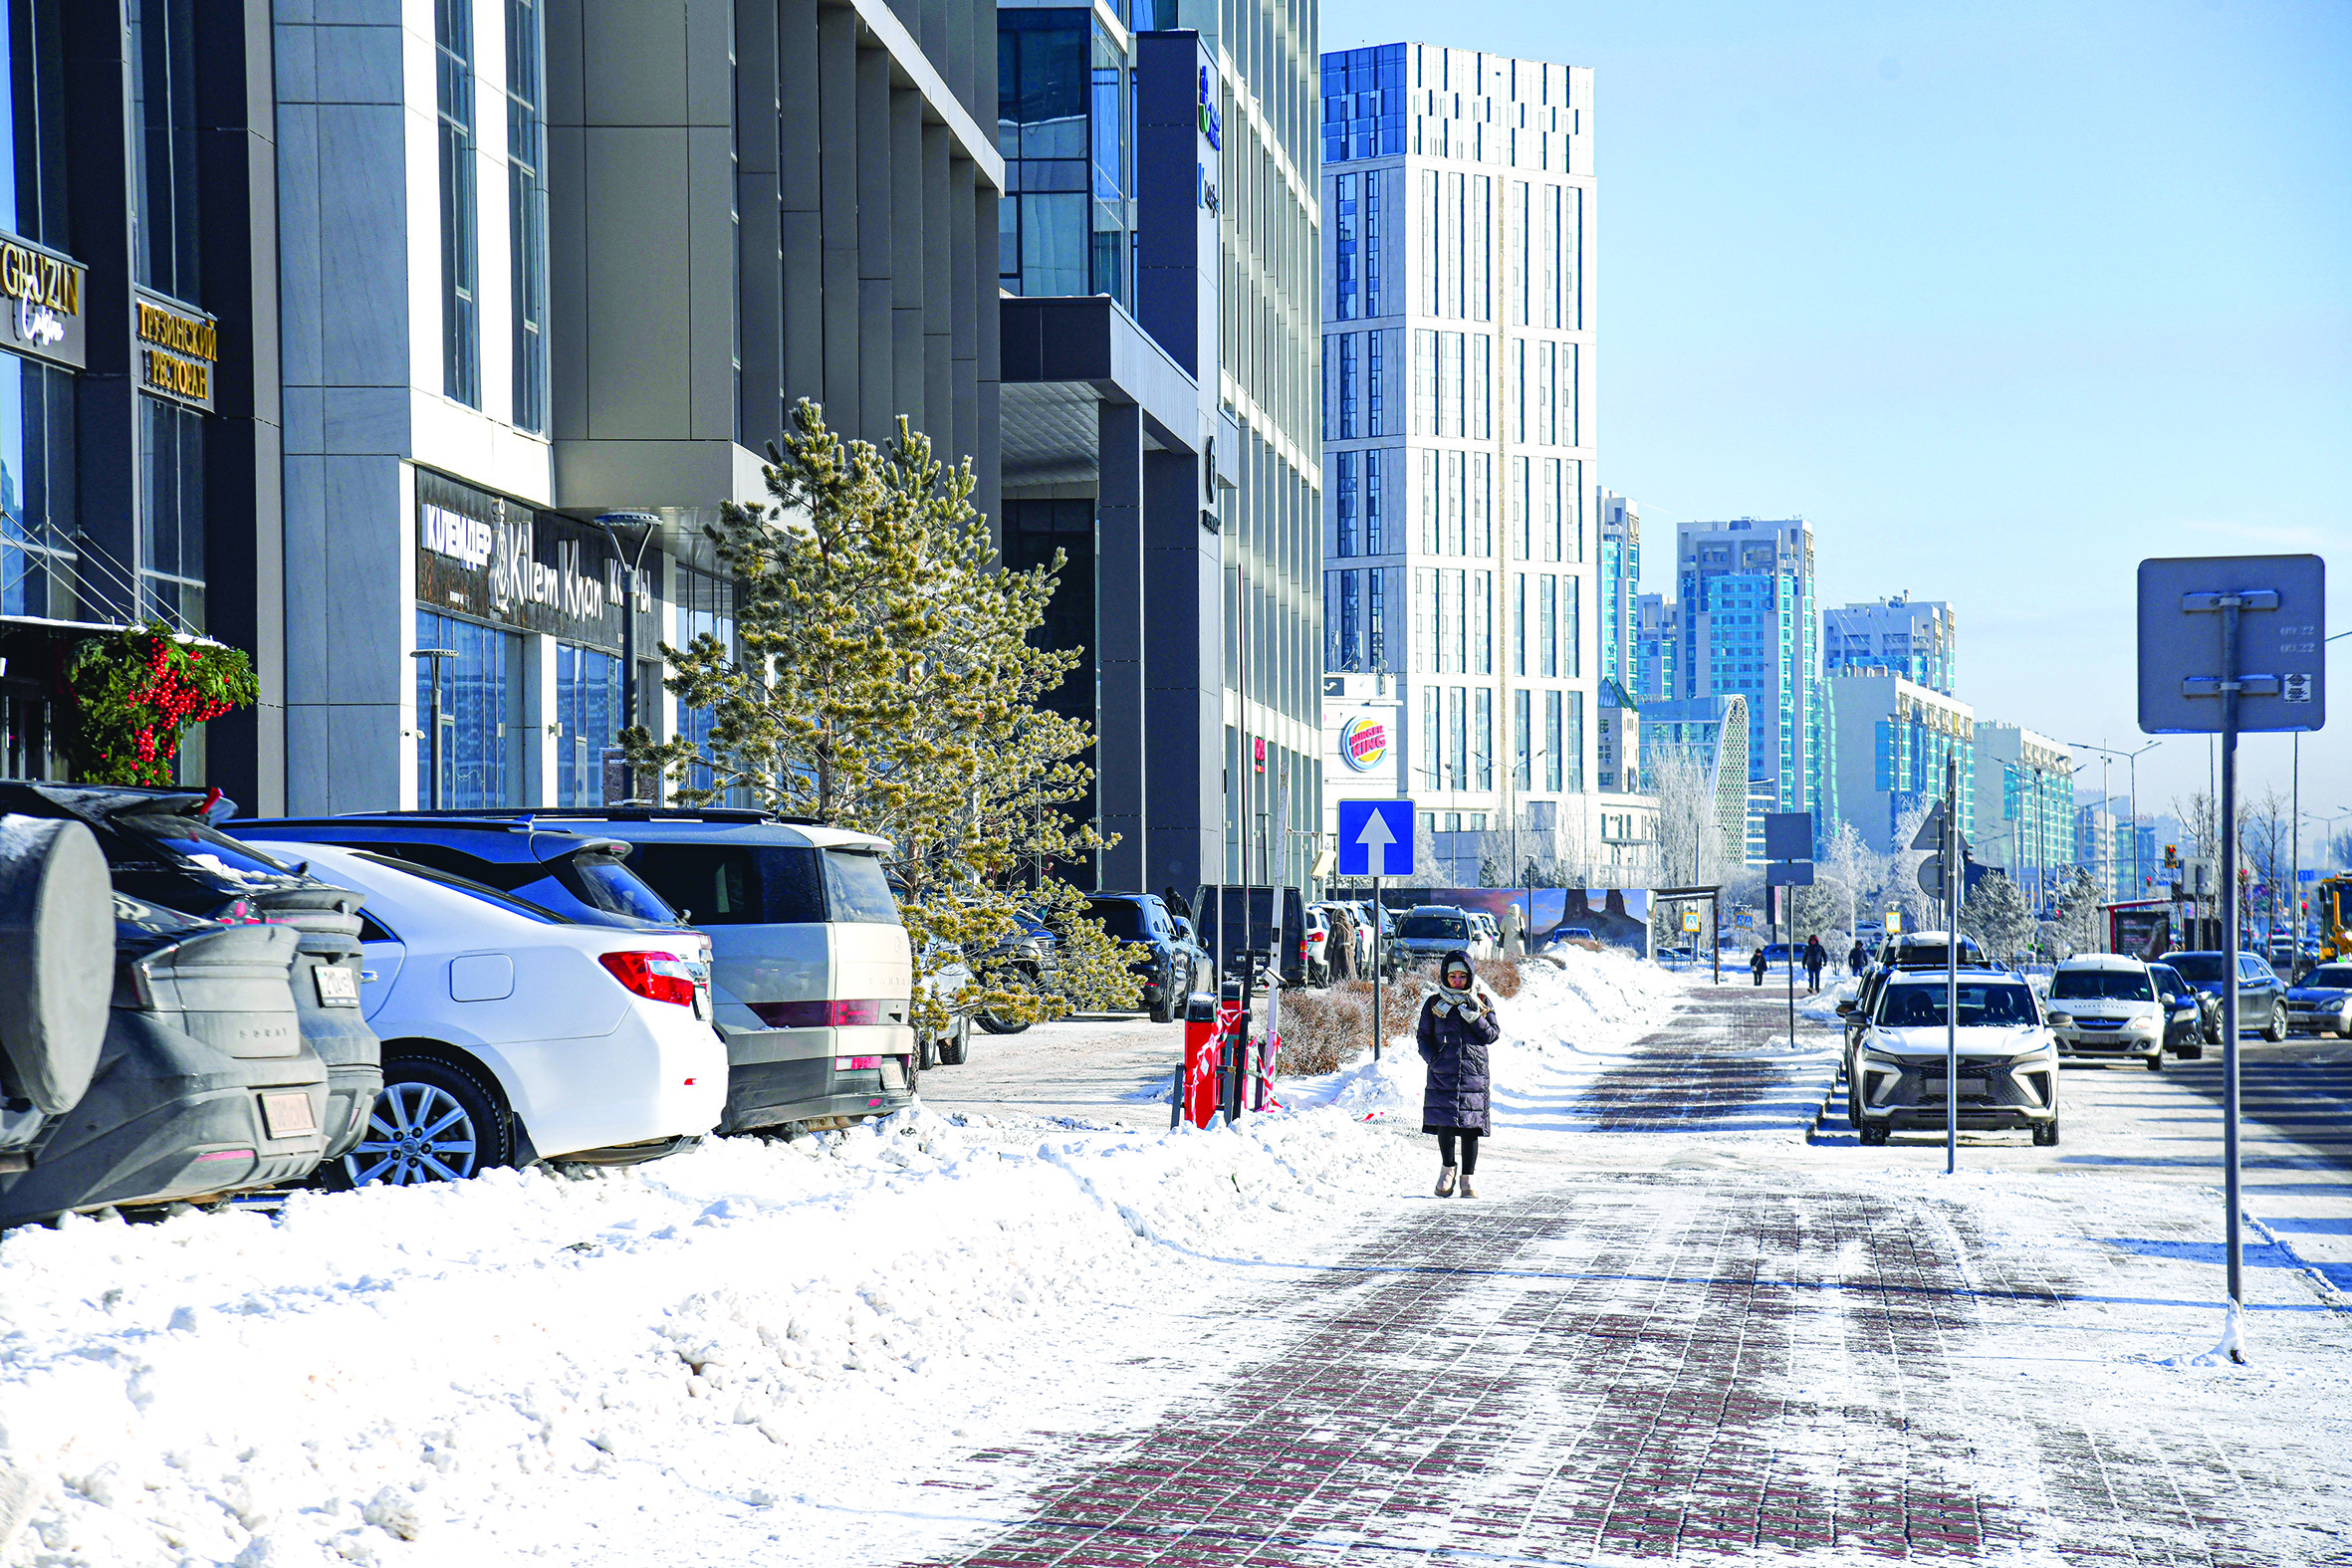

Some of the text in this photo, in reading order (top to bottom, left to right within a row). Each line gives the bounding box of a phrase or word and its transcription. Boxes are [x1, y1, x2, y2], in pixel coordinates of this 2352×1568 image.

[3, 243, 79, 317] GRUZIN
[139, 303, 218, 362] ГРУЗИНСКИЙ
[151, 350, 209, 400] РЕСТОРАН
[510, 521, 603, 622] Kilem Khan
[1349, 725, 1383, 746] BURGER
[1352, 735, 1386, 759] KING
